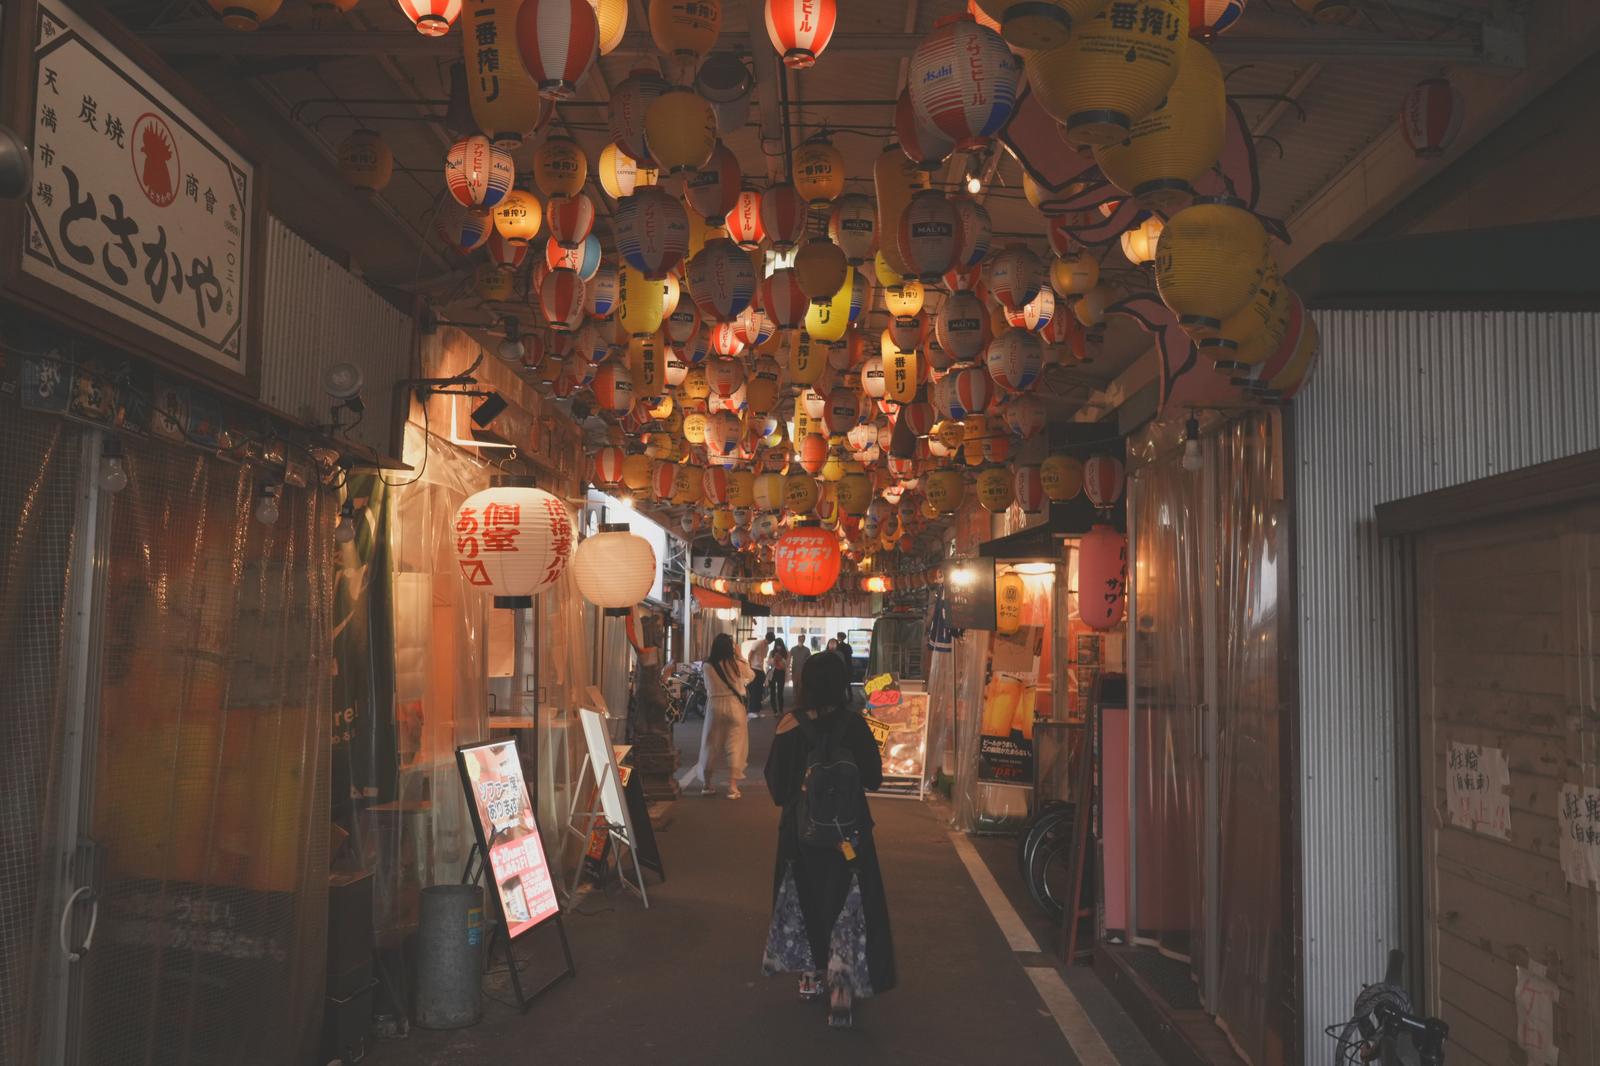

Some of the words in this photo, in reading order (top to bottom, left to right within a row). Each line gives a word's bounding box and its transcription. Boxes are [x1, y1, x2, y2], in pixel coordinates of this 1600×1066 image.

[474, 9, 500, 103] 一番搾り
[924, 65, 953, 81] Asahi
[967, 34, 986, 106] アサヒビール
[37, 67, 59, 208] 天満市場
[79, 94, 126, 150] 炭焼
[472, 142, 484, 188] アサヒビール
[544, 160, 578, 172] 一番搾り
[798, 164, 831, 176] 一番搾り
[185, 174, 218, 215] 商會
[497, 208, 527, 219] 一番搾り
[60, 165, 223, 328] とさかや
[892, 291, 918, 299] 一番搾り
[895, 356, 906, 394] 番搾り
[456, 508, 479, 559] あり
[482, 502, 520, 552] 個室
[1448, 749, 1479, 770] 駐輪
[489, 797, 518, 820] あります
